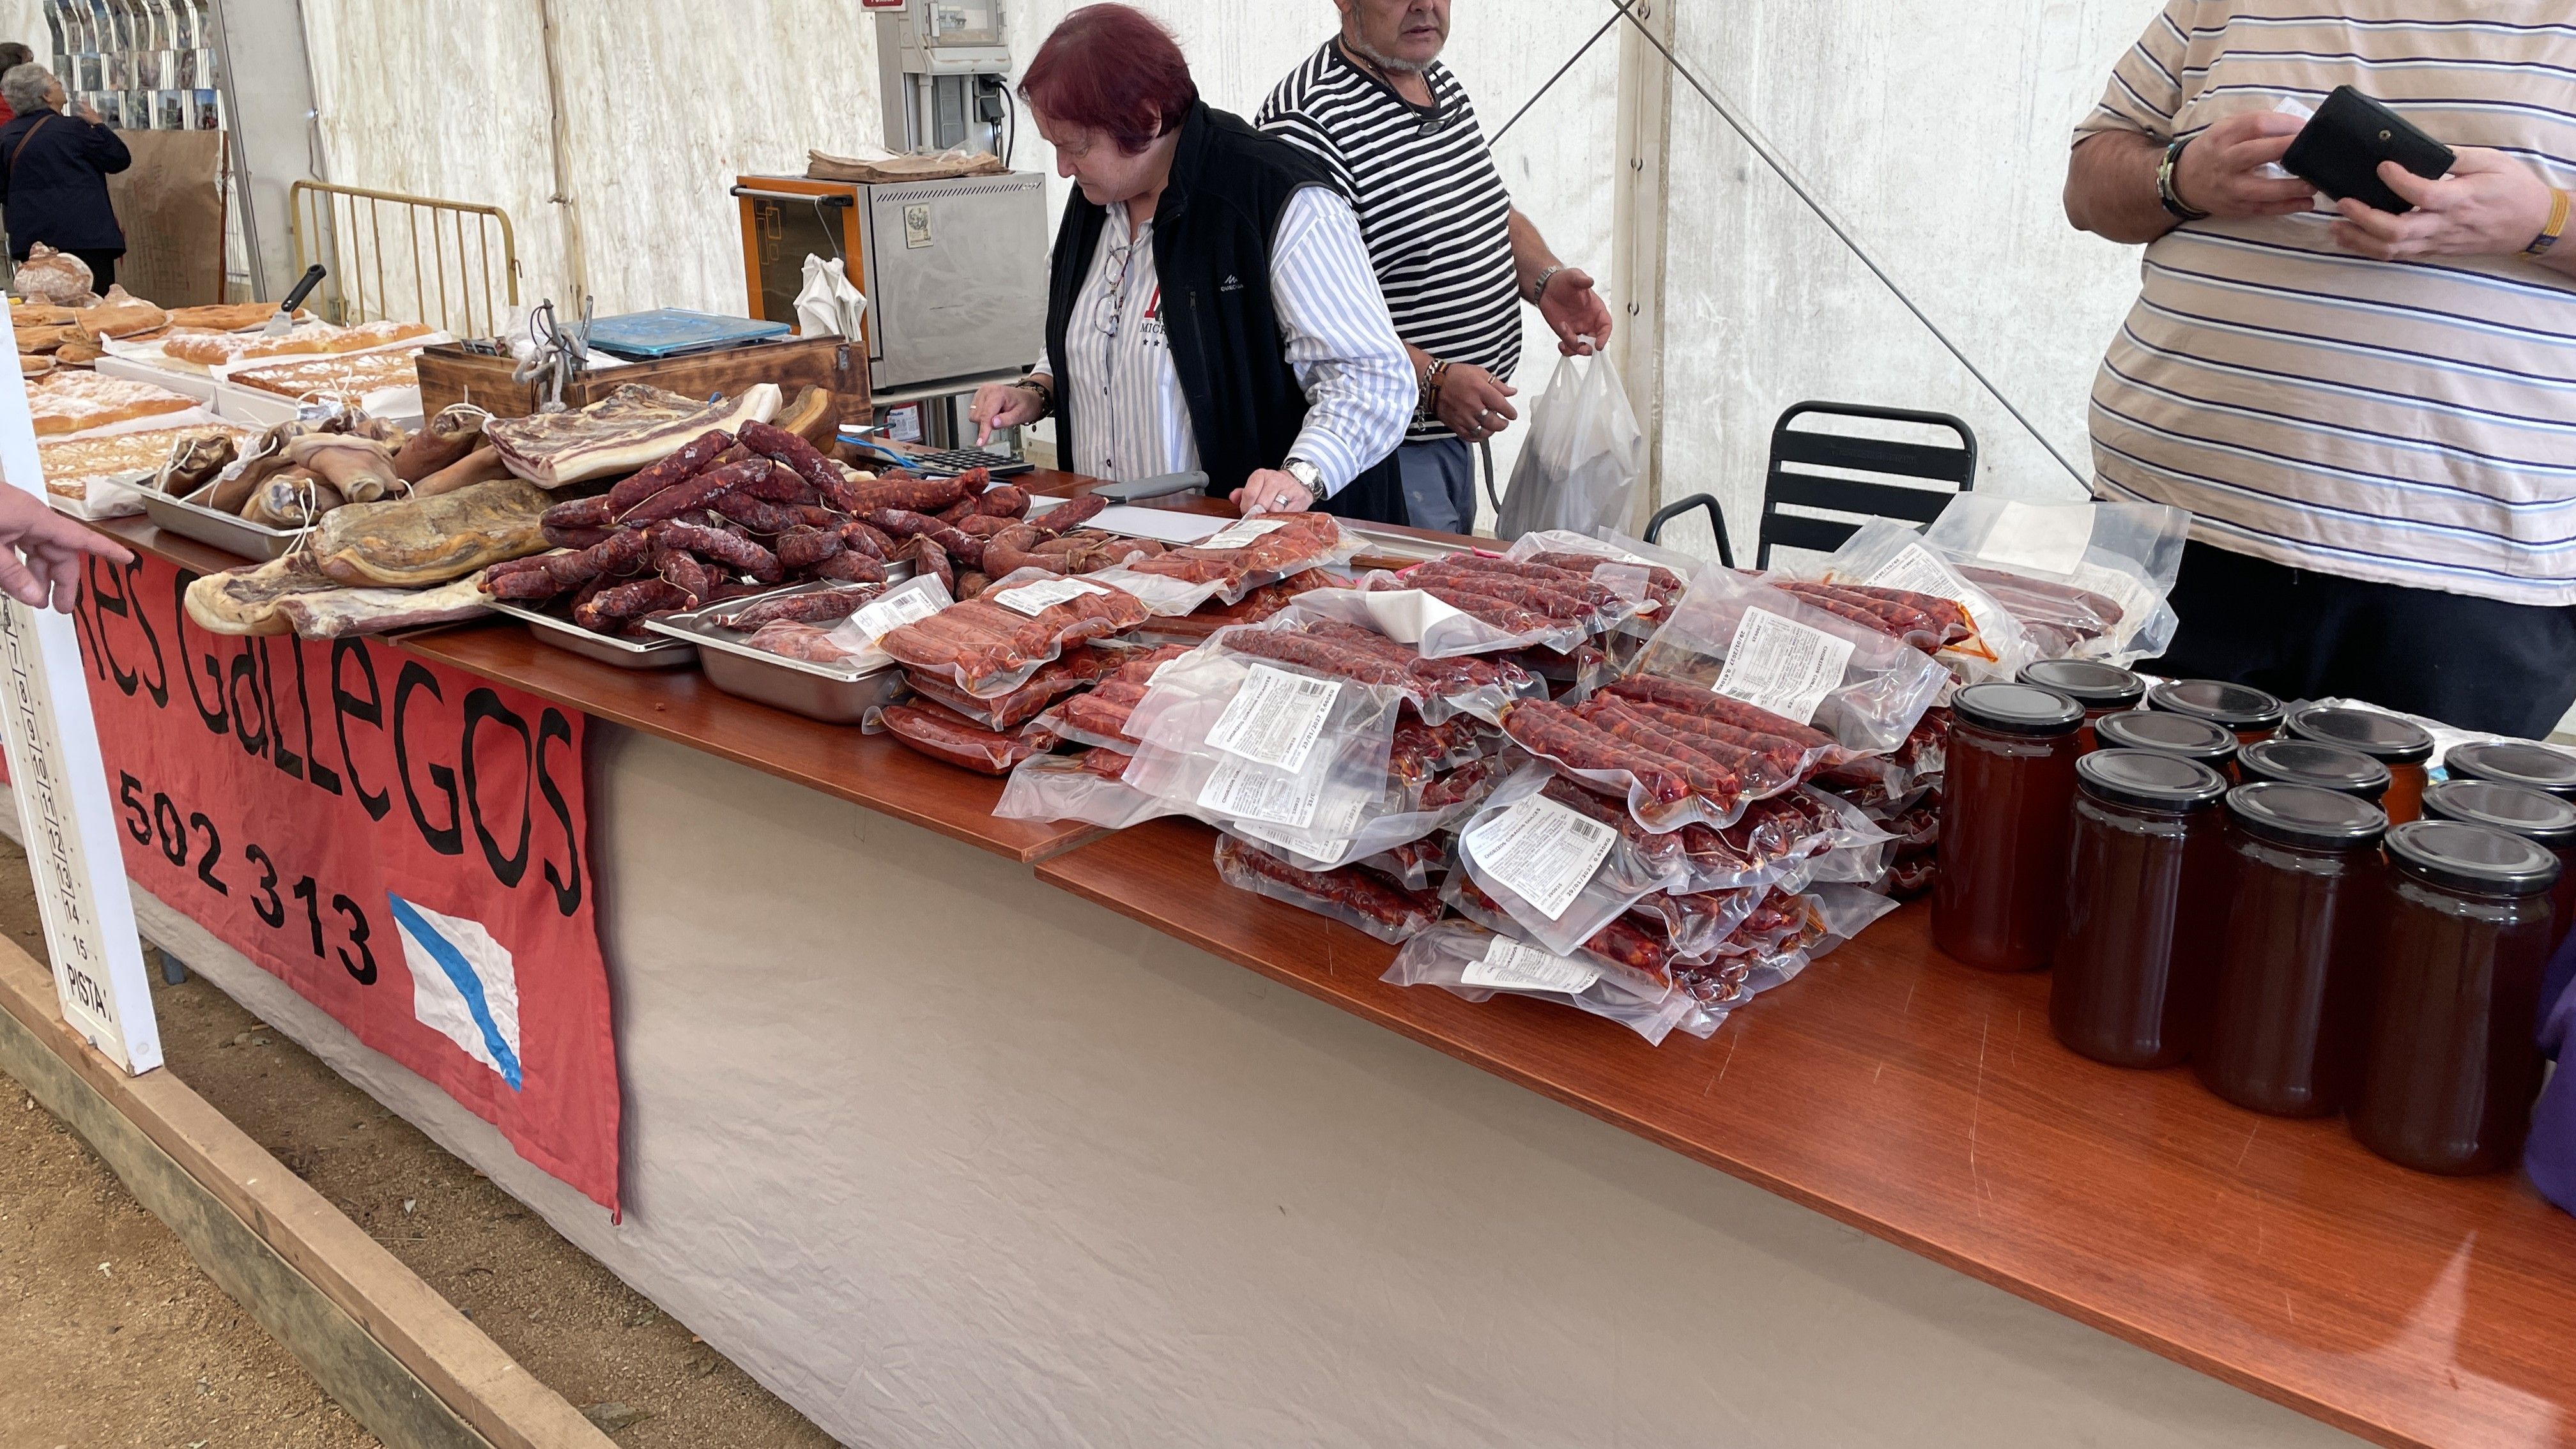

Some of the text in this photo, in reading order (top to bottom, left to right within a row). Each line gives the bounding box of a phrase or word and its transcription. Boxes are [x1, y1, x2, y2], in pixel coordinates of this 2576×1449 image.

[1729, 630, 1745, 665] 29/01/2027
[1814, 645, 1828, 673] CHORIZOS
[19, 680, 27, 703] 8
[27, 718, 35, 741] 9
[1302, 715, 1321, 749] 23/01/2027
[33, 754, 47, 780] 10
[42, 791, 54, 818] 11
[49, 828, 65, 855] 12
[56, 864, 72, 891] 13
[120, 769, 377, 986] 502 313
[1566, 864, 1593, 896] 29/01/2027
[65, 900, 79, 926] 14
[73, 934, 88, 960] 15
